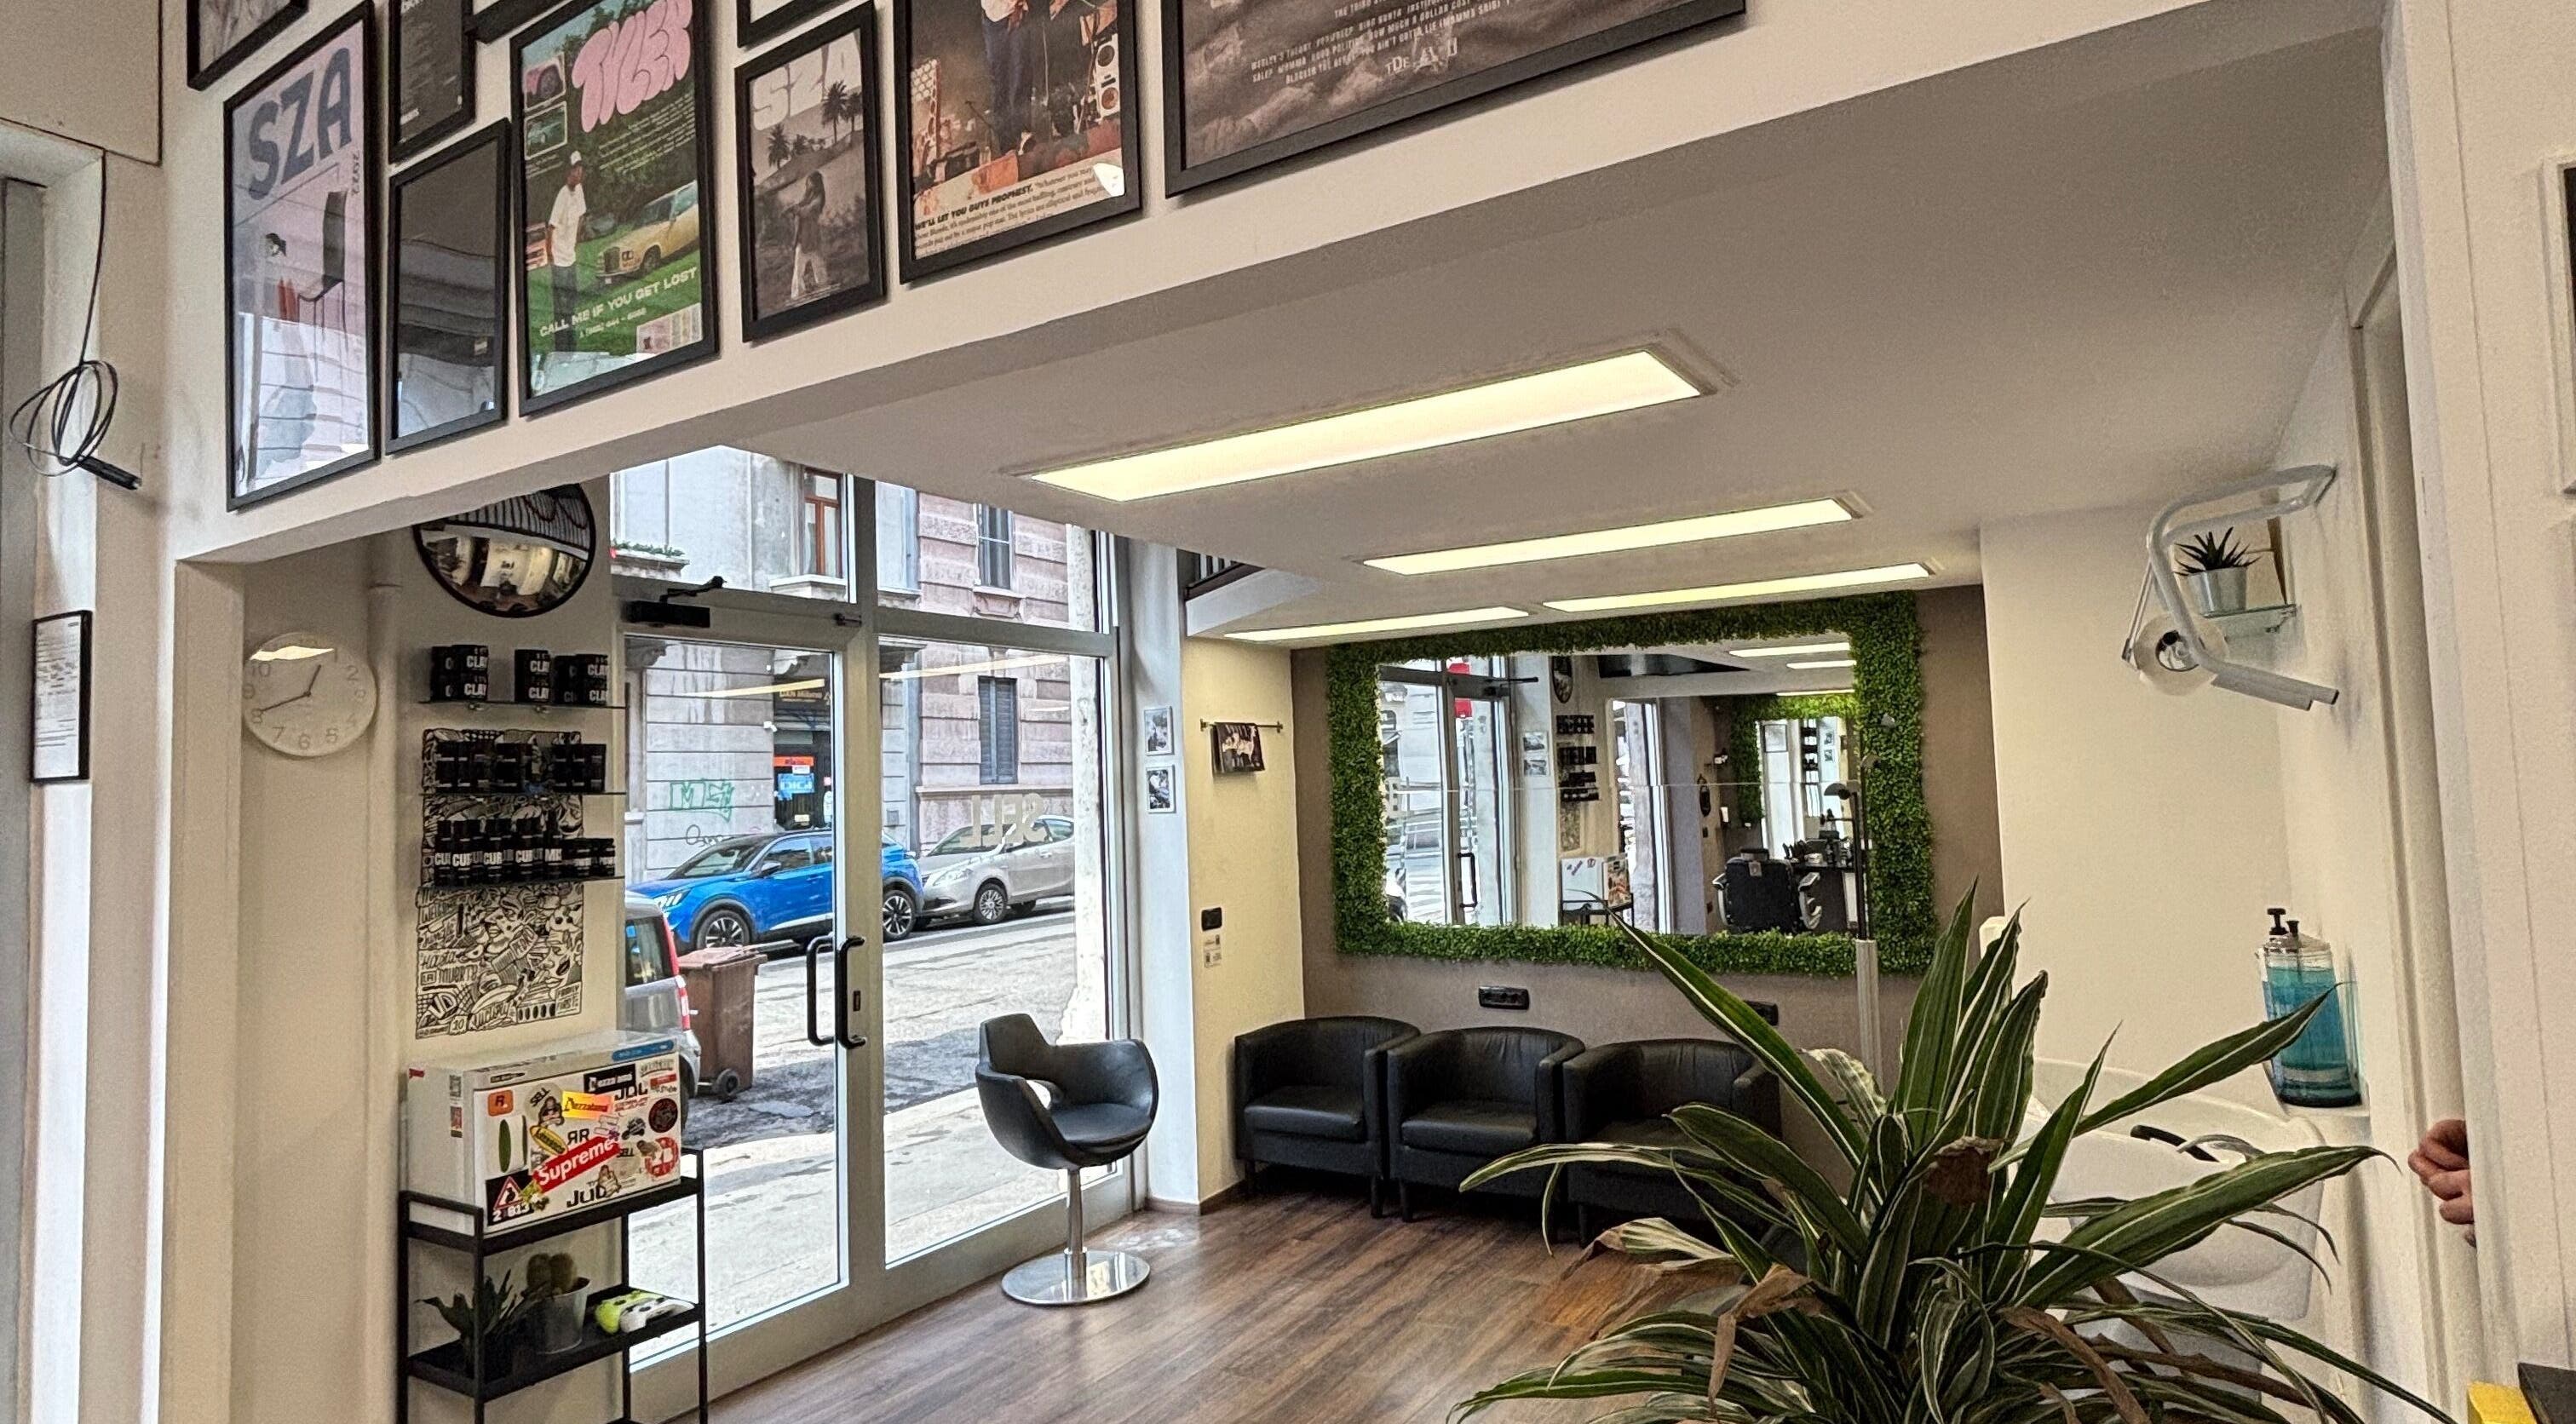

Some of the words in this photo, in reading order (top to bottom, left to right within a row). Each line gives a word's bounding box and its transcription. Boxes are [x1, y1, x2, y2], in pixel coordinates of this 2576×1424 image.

[248, 48, 353, 200] SZA
[951, 206, 968, 218] YOU
[539, 319, 570, 337] CALL
[572, 308, 590, 326] ME
[592, 303, 605, 318] IF
[607, 291, 633, 311] YOU
[635, 280, 660, 301] GET
[663, 267, 697, 290] LOST
[298, 733, 311, 750] 6
[538, 1138, 614, 1186] Supreme
